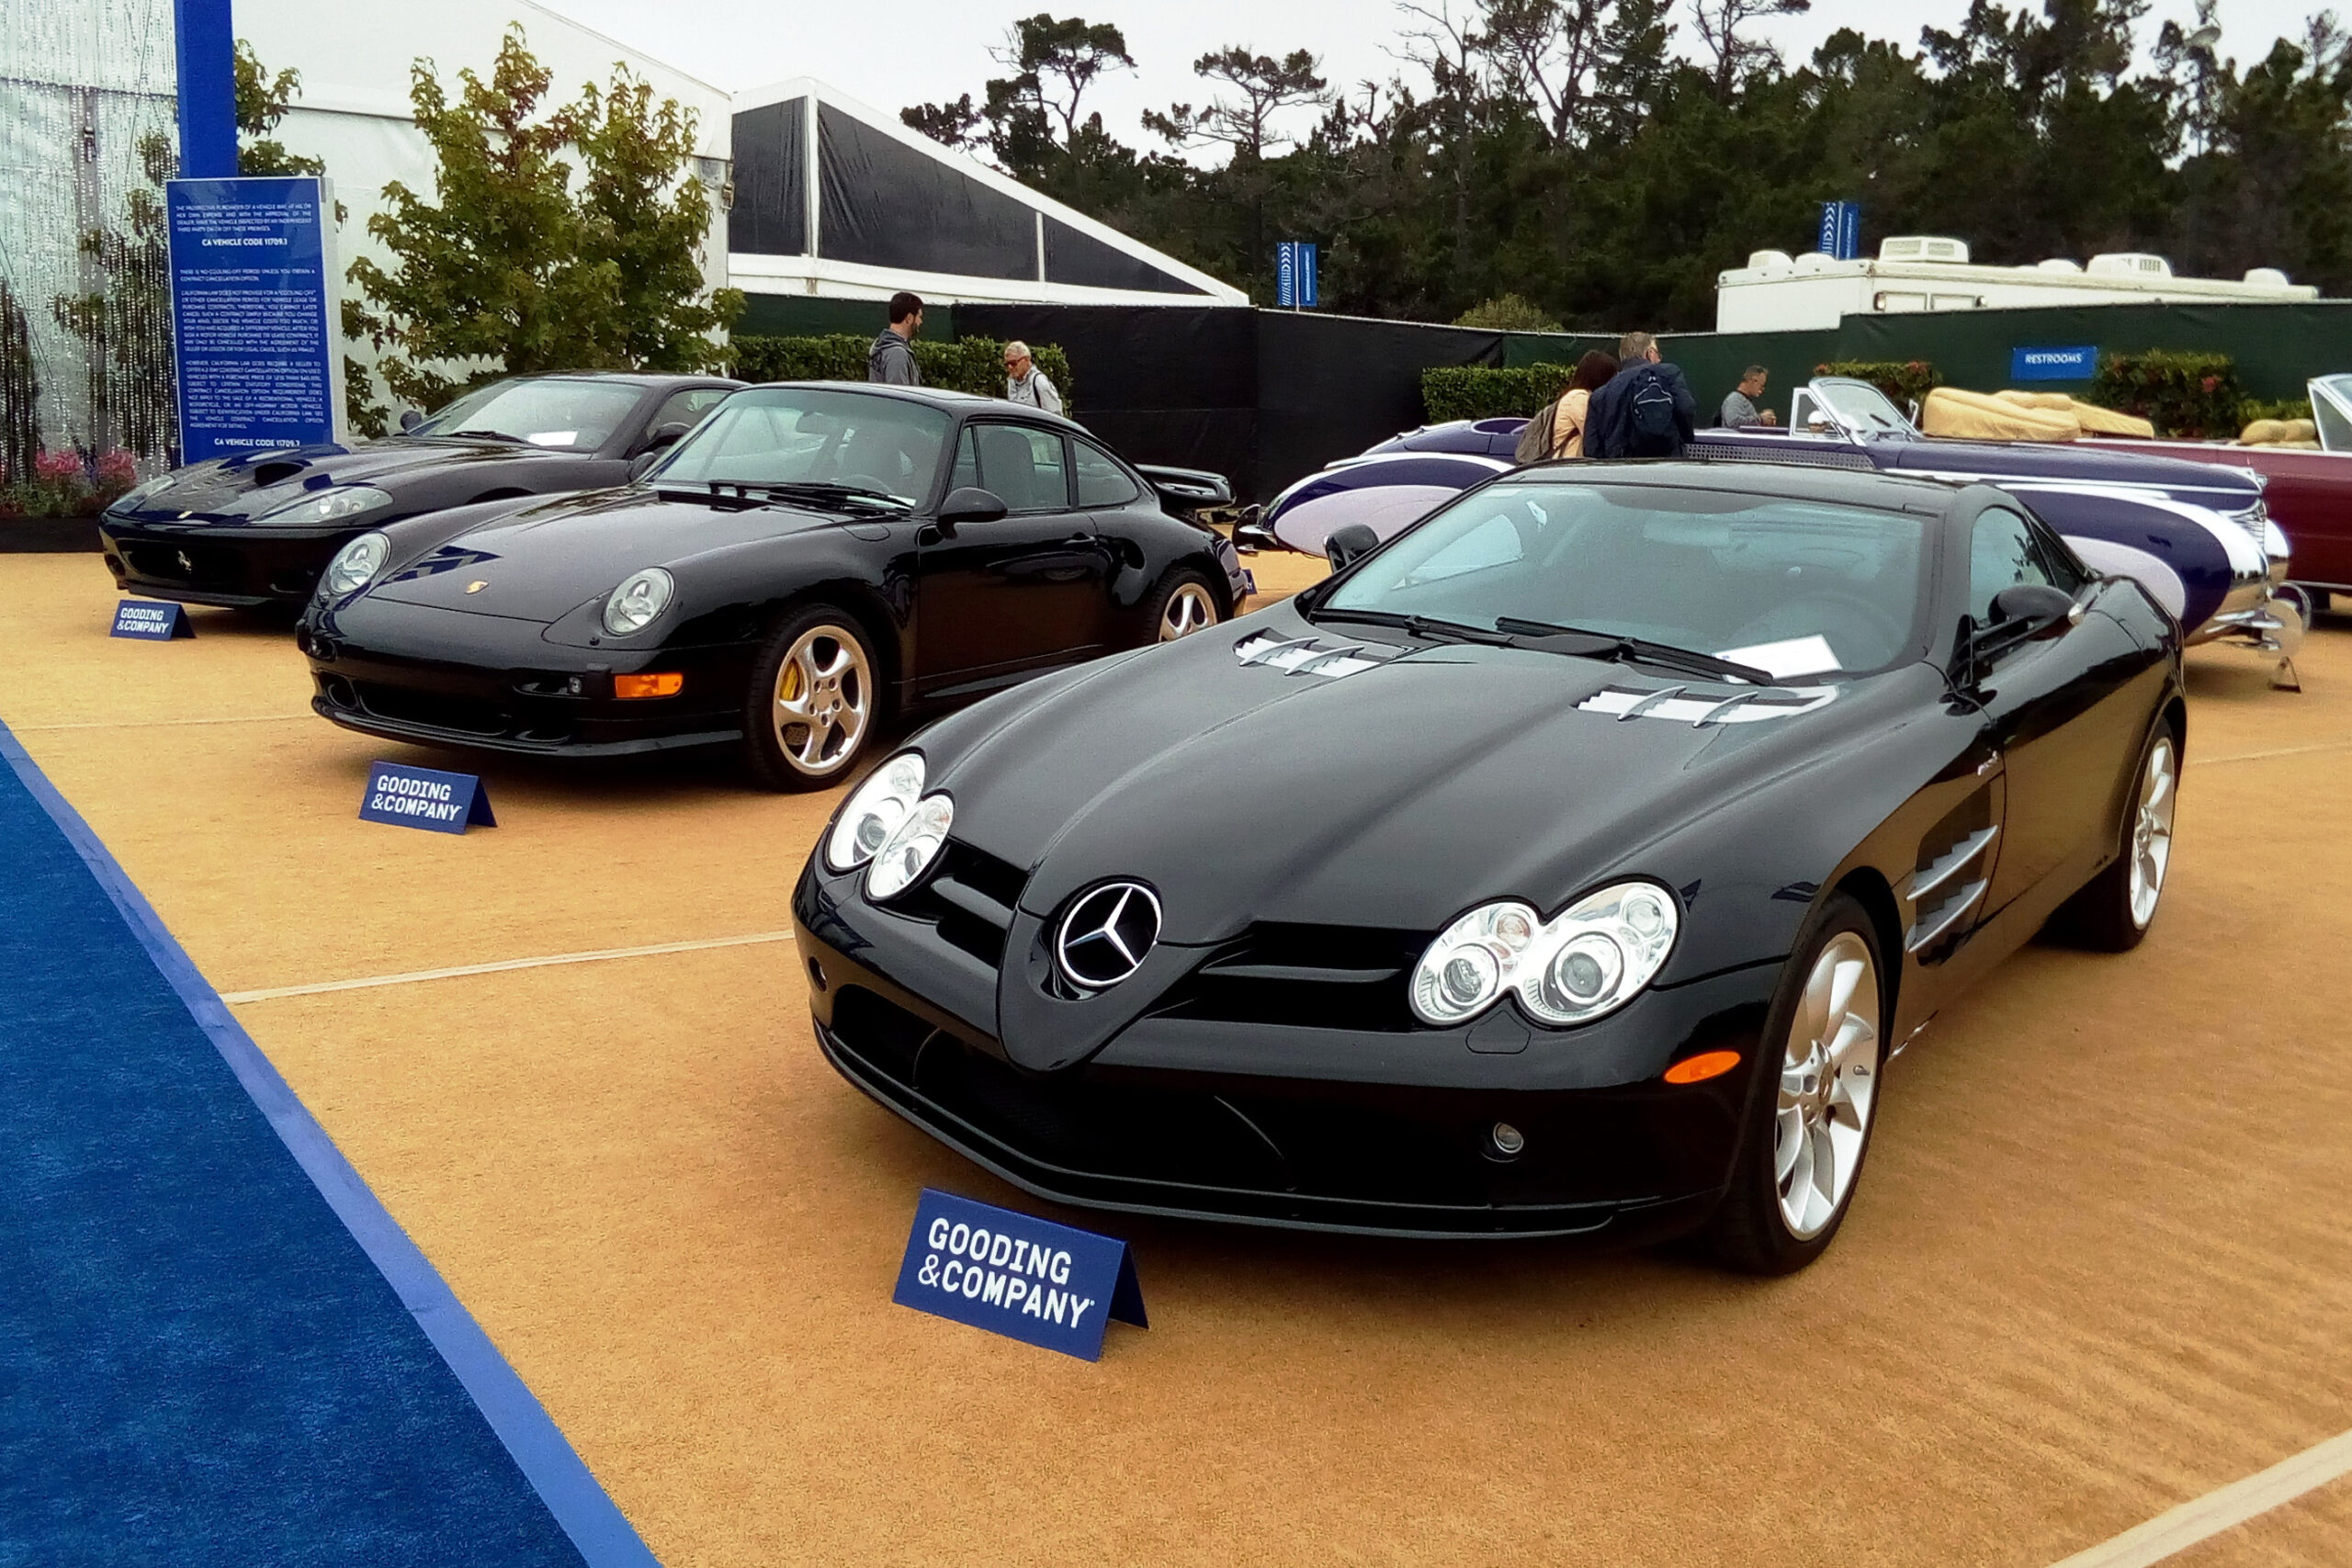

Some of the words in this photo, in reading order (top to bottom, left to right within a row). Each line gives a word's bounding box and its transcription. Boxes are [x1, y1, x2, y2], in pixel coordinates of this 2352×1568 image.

[2025, 353, 2083, 365] RESTROOMS
[117, 619, 169, 634] &COMPANY
[120, 607, 164, 621] GOODING
[377, 774, 451, 801] GOODING
[371, 793, 461, 821] &COMPANY
[928, 1217, 1072, 1285] GOODING
[918, 1254, 1095, 1328] &COMPANY
